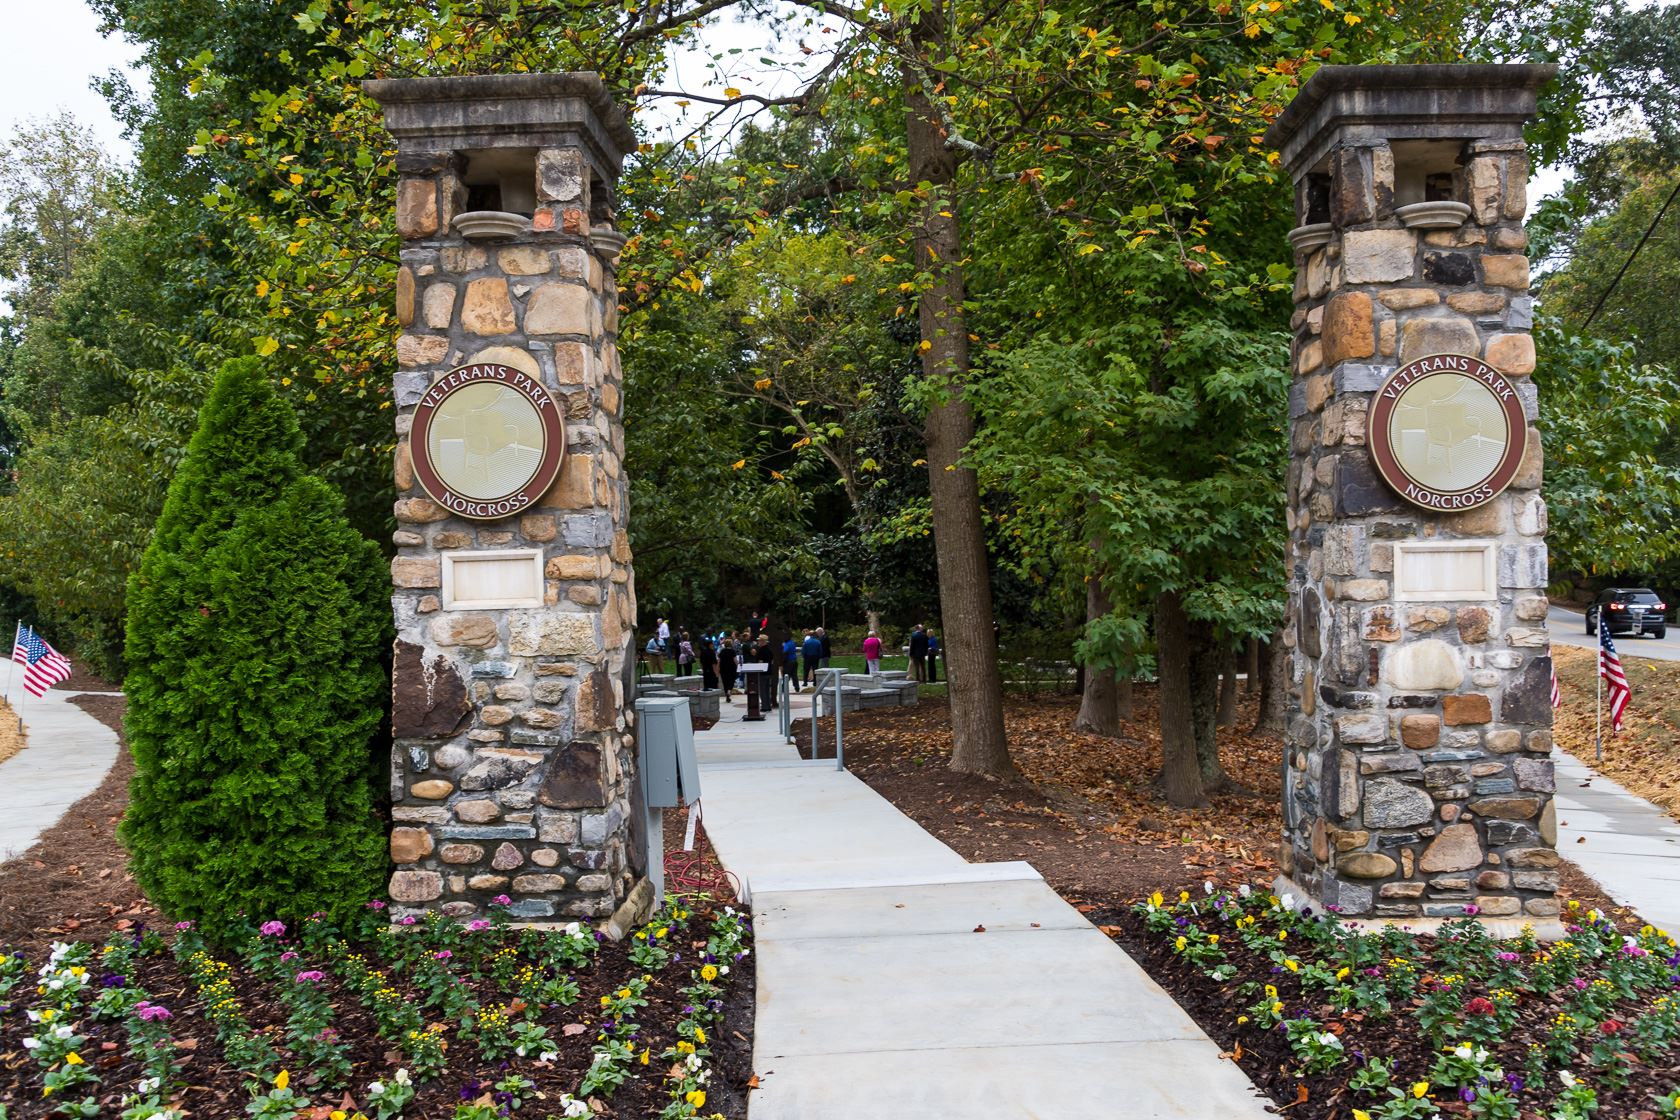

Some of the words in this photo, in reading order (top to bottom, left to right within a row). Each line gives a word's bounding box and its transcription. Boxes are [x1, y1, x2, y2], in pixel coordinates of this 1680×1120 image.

[422, 365, 507, 408] VETERANS
[513, 373, 550, 409] PARK
[1383, 356, 1468, 400] VETERANS
[1475, 365, 1514, 401] PARK
[441, 492, 529, 516] NORCROSS
[1404, 483, 1494, 508] NORCROSS
